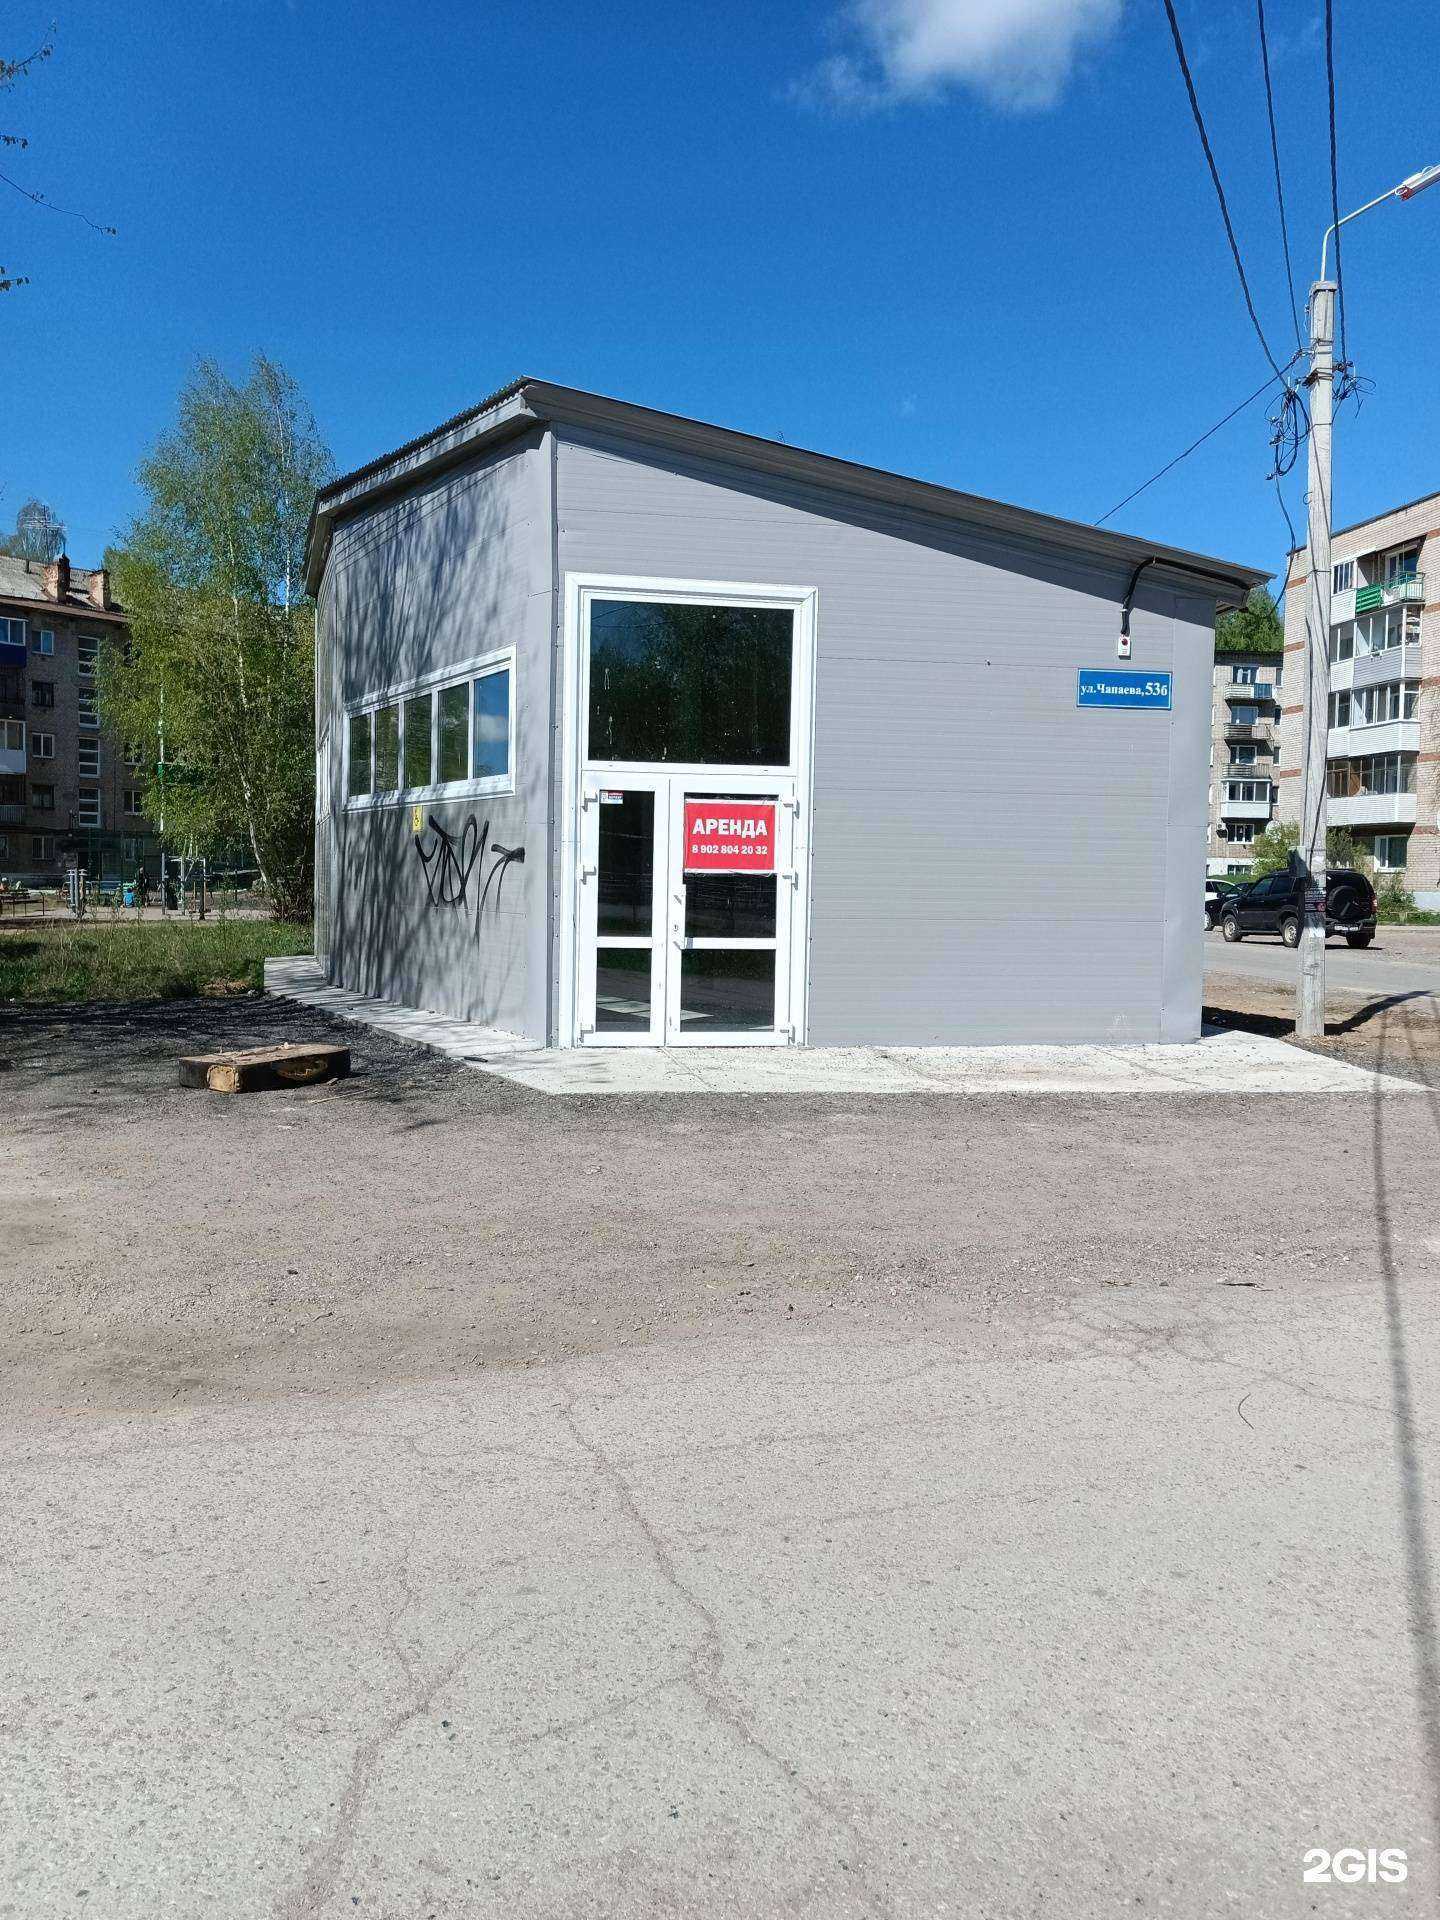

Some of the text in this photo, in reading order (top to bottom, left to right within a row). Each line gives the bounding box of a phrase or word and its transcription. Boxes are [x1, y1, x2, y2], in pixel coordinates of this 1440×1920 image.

[692, 818, 768, 839] АРЕНДА
[692, 844, 768, 855] 8 902 804 20 32
